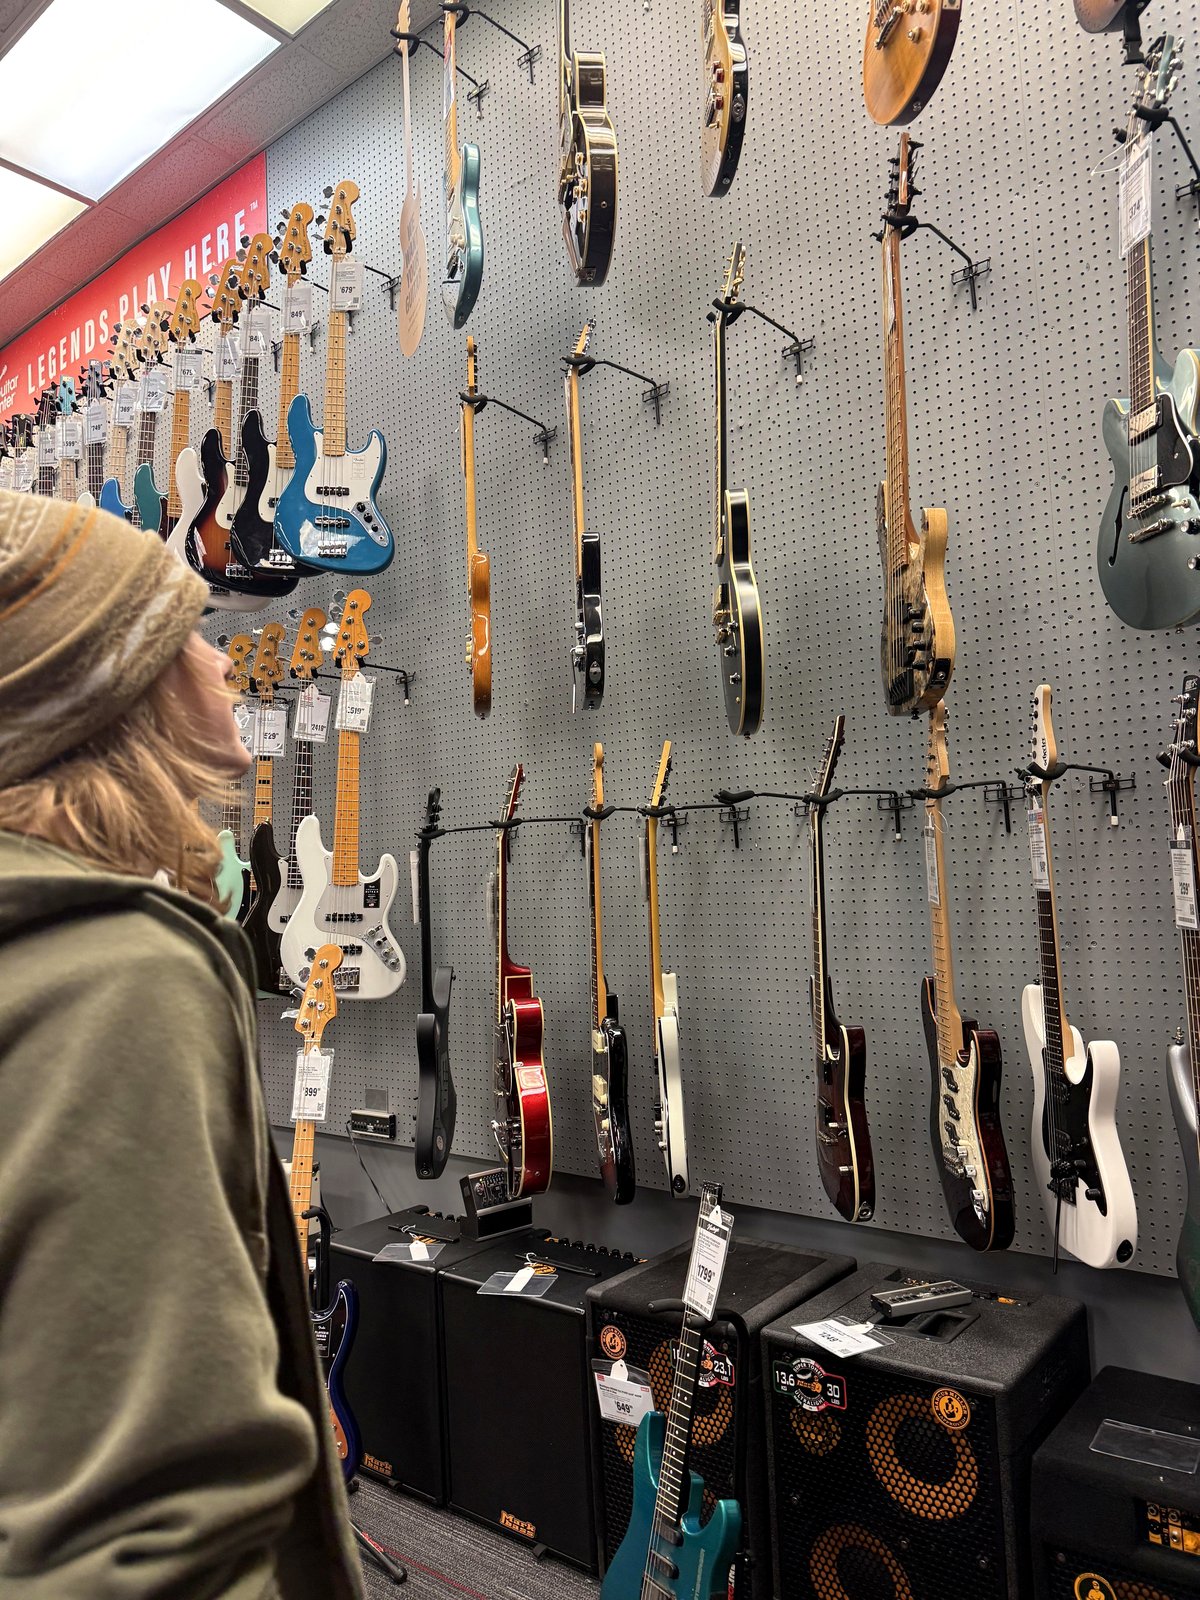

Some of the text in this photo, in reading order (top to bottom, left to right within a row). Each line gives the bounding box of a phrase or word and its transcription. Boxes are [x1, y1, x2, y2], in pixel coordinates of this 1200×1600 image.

[28, 309, 109, 394] LEGENDS
[119, 261, 171, 325] PLAY
[184, 209, 245, 280] HERE
[0, 375, 19, 398] uitar
[713, 1360, 731, 1377] 23.1
[775, 1370, 795, 1387] 13.6
[826, 1383, 840, 1398] 30
